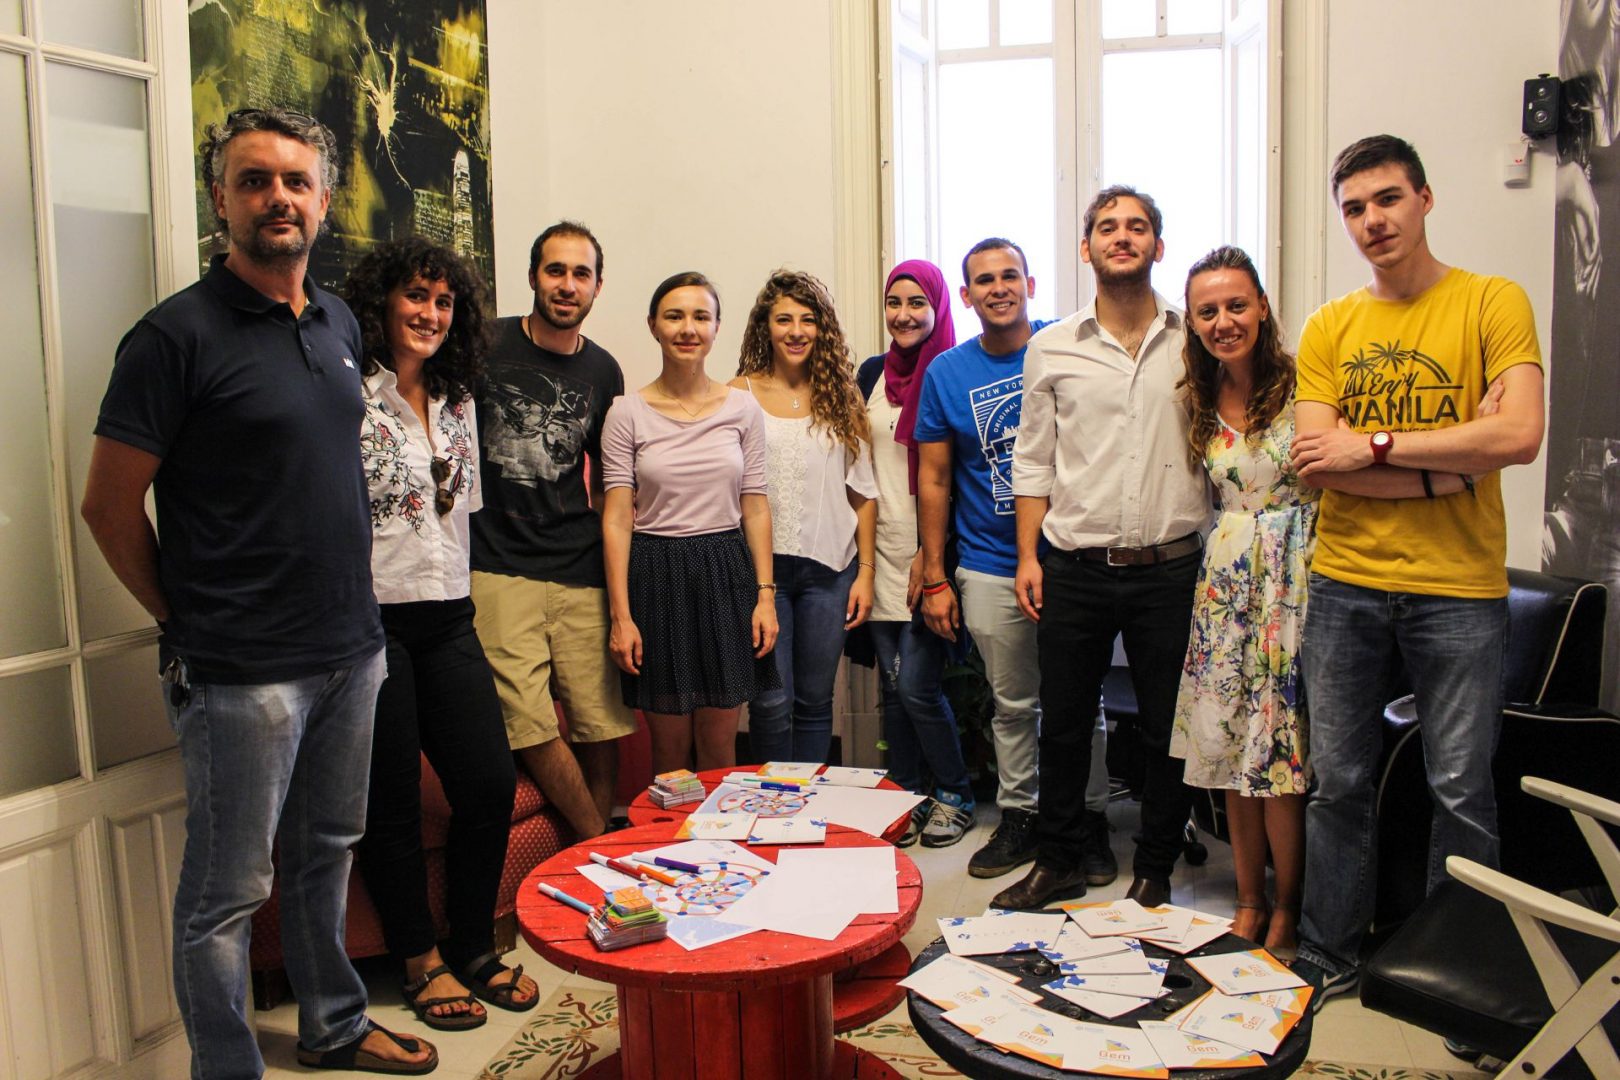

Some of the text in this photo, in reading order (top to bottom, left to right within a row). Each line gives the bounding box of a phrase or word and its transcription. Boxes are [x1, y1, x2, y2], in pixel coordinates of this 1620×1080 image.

[979, 380, 1023, 400] NEW YOR
[993, 402, 1019, 433] ORIGINAL
[1019, 1030, 1048, 1045] Gem
[1099, 1050, 1131, 1060] Gem
[1186, 1045, 1218, 1053] Gem
